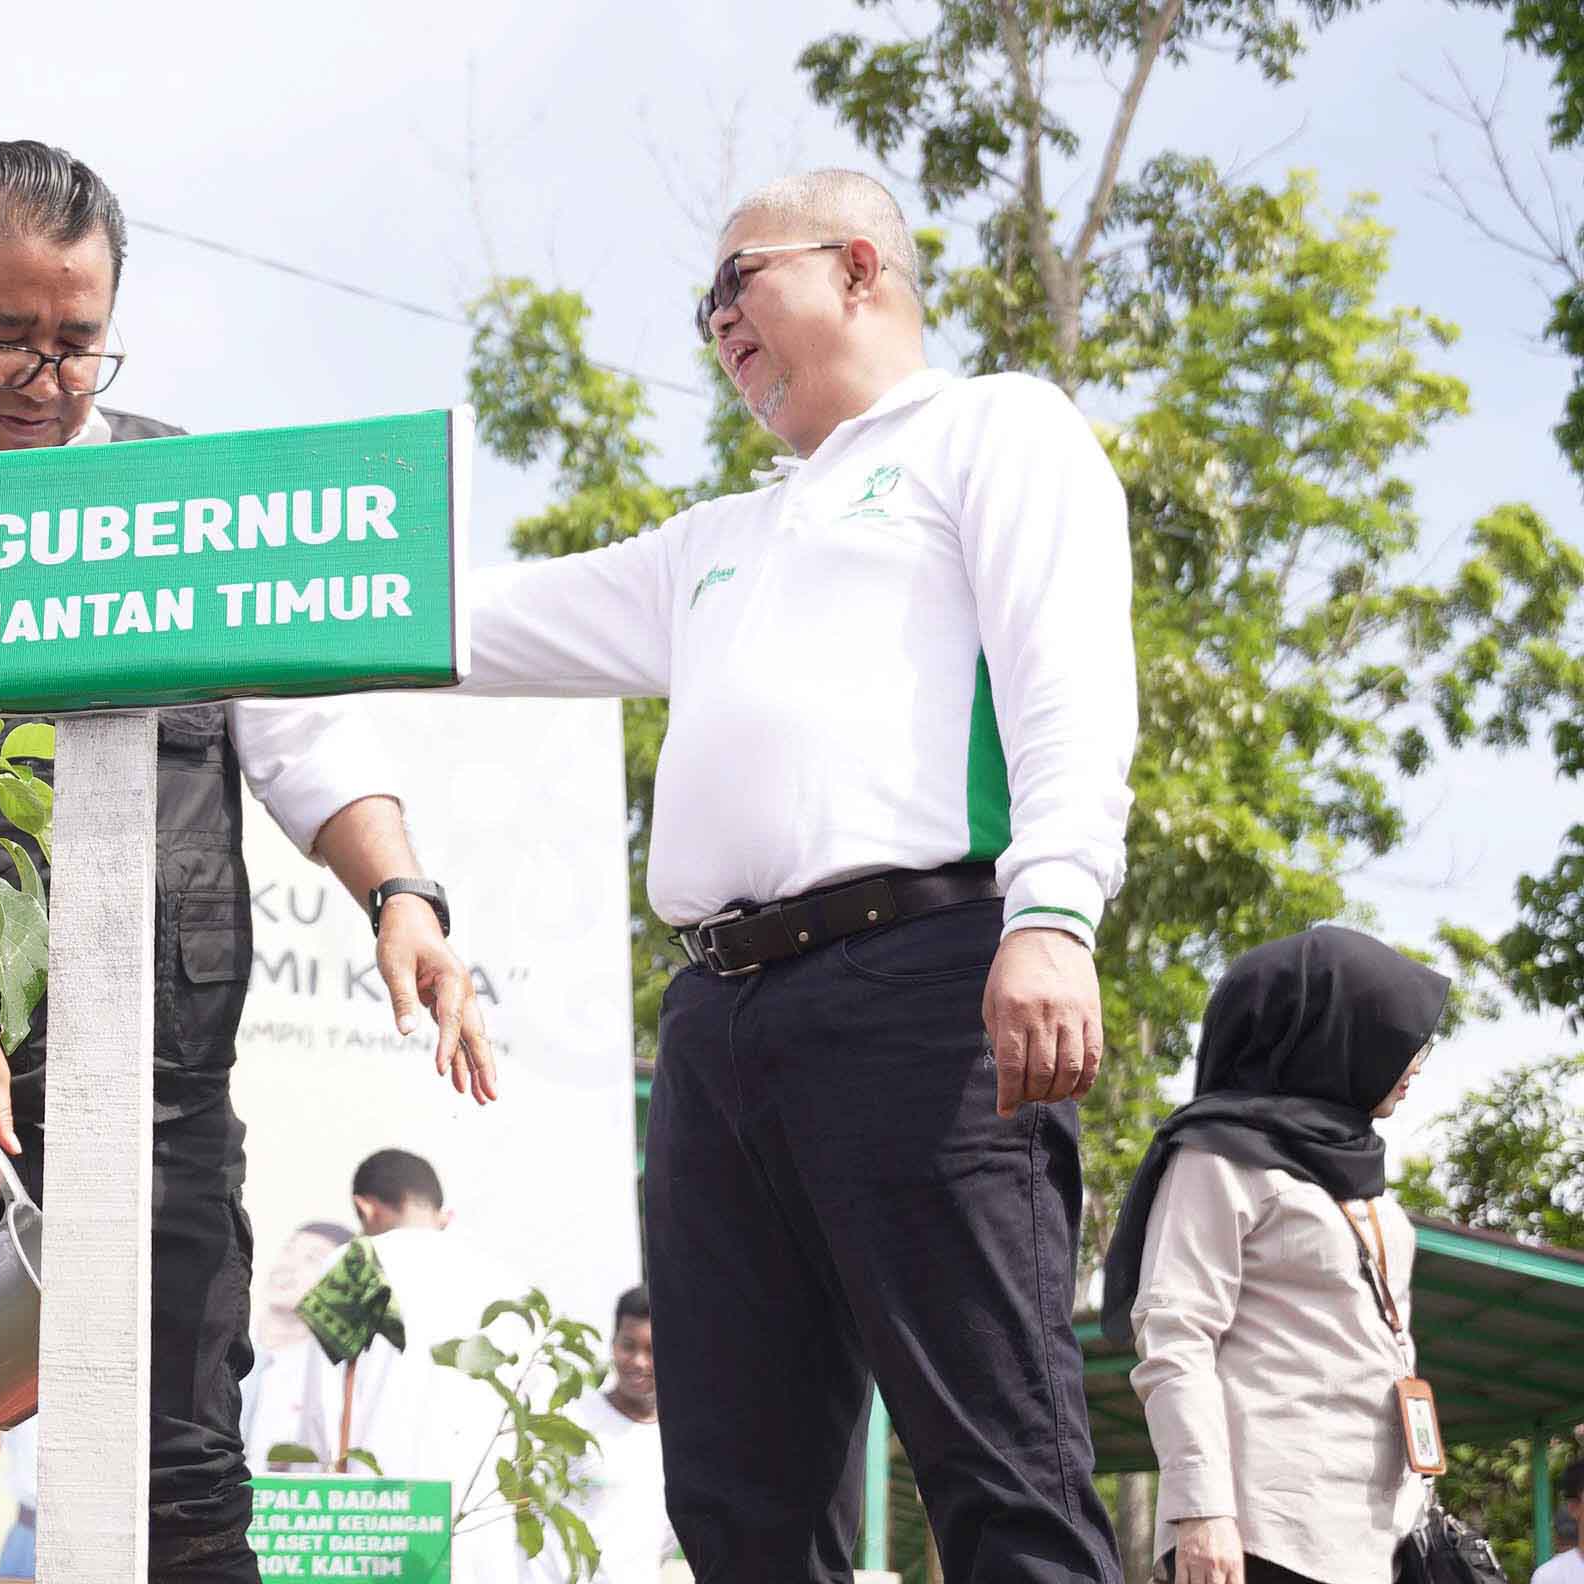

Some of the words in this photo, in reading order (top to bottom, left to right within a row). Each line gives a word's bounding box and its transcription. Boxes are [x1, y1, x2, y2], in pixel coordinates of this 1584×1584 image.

[217, 573, 413, 628] TIMUR
[250, 882, 326, 925] KU
[247, 949, 318, 997] MI
[252, 1489, 322, 1511] EPALA
[327, 1490, 411, 1512] BADAN
[251, 1514, 334, 1532] ELOLAAN
[337, 1515, 445, 1534] KEUANGAN
[245, 1534, 270, 1551] AN
[274, 1534, 324, 1551] ASET
[328, 1535, 409, 1553] DAERAH
[257, 1554, 305, 1576] ROV.
[311, 1555, 403, 1577] KALTIM
